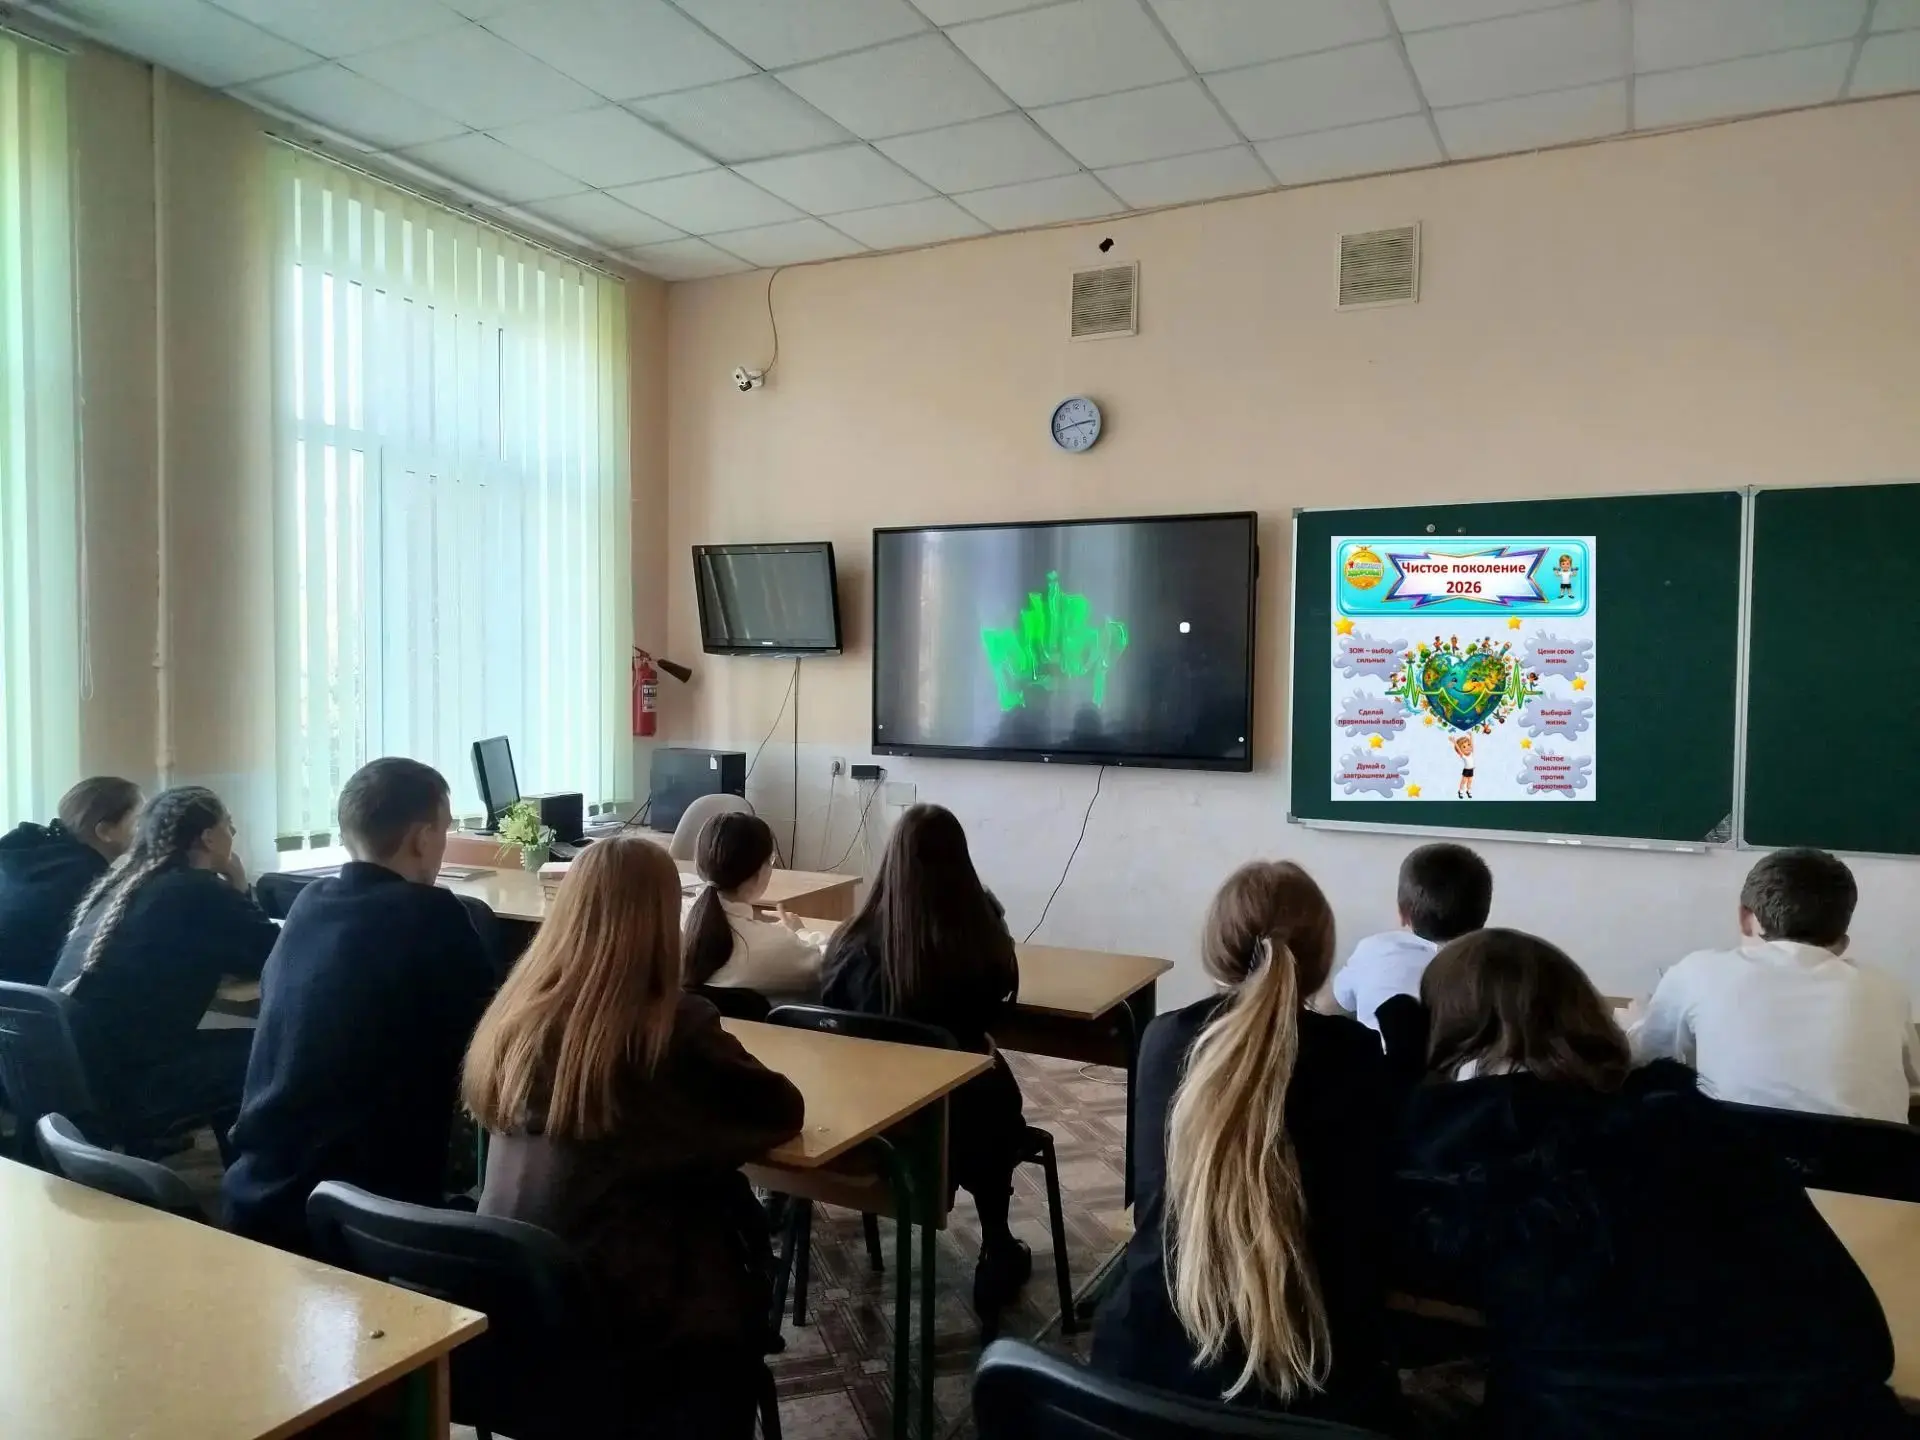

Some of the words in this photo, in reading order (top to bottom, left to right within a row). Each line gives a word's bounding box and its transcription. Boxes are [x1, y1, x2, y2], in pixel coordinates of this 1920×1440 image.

[1401, 562, 1449, 573] Чистое
[1452, 562, 1526, 573] поколение
[1446, 581, 1482, 594] 2026
[1371, 647, 1394, 655] выбор
[1537, 648, 1556, 656] Цени
[1358, 708, 1384, 716] Сделай
[1540, 709, 1572, 717] Выбирай
[1382, 718, 1404, 726] выбор
[1356, 762, 1380, 771] Думай
[1532, 783, 1573, 791] наркотиков
